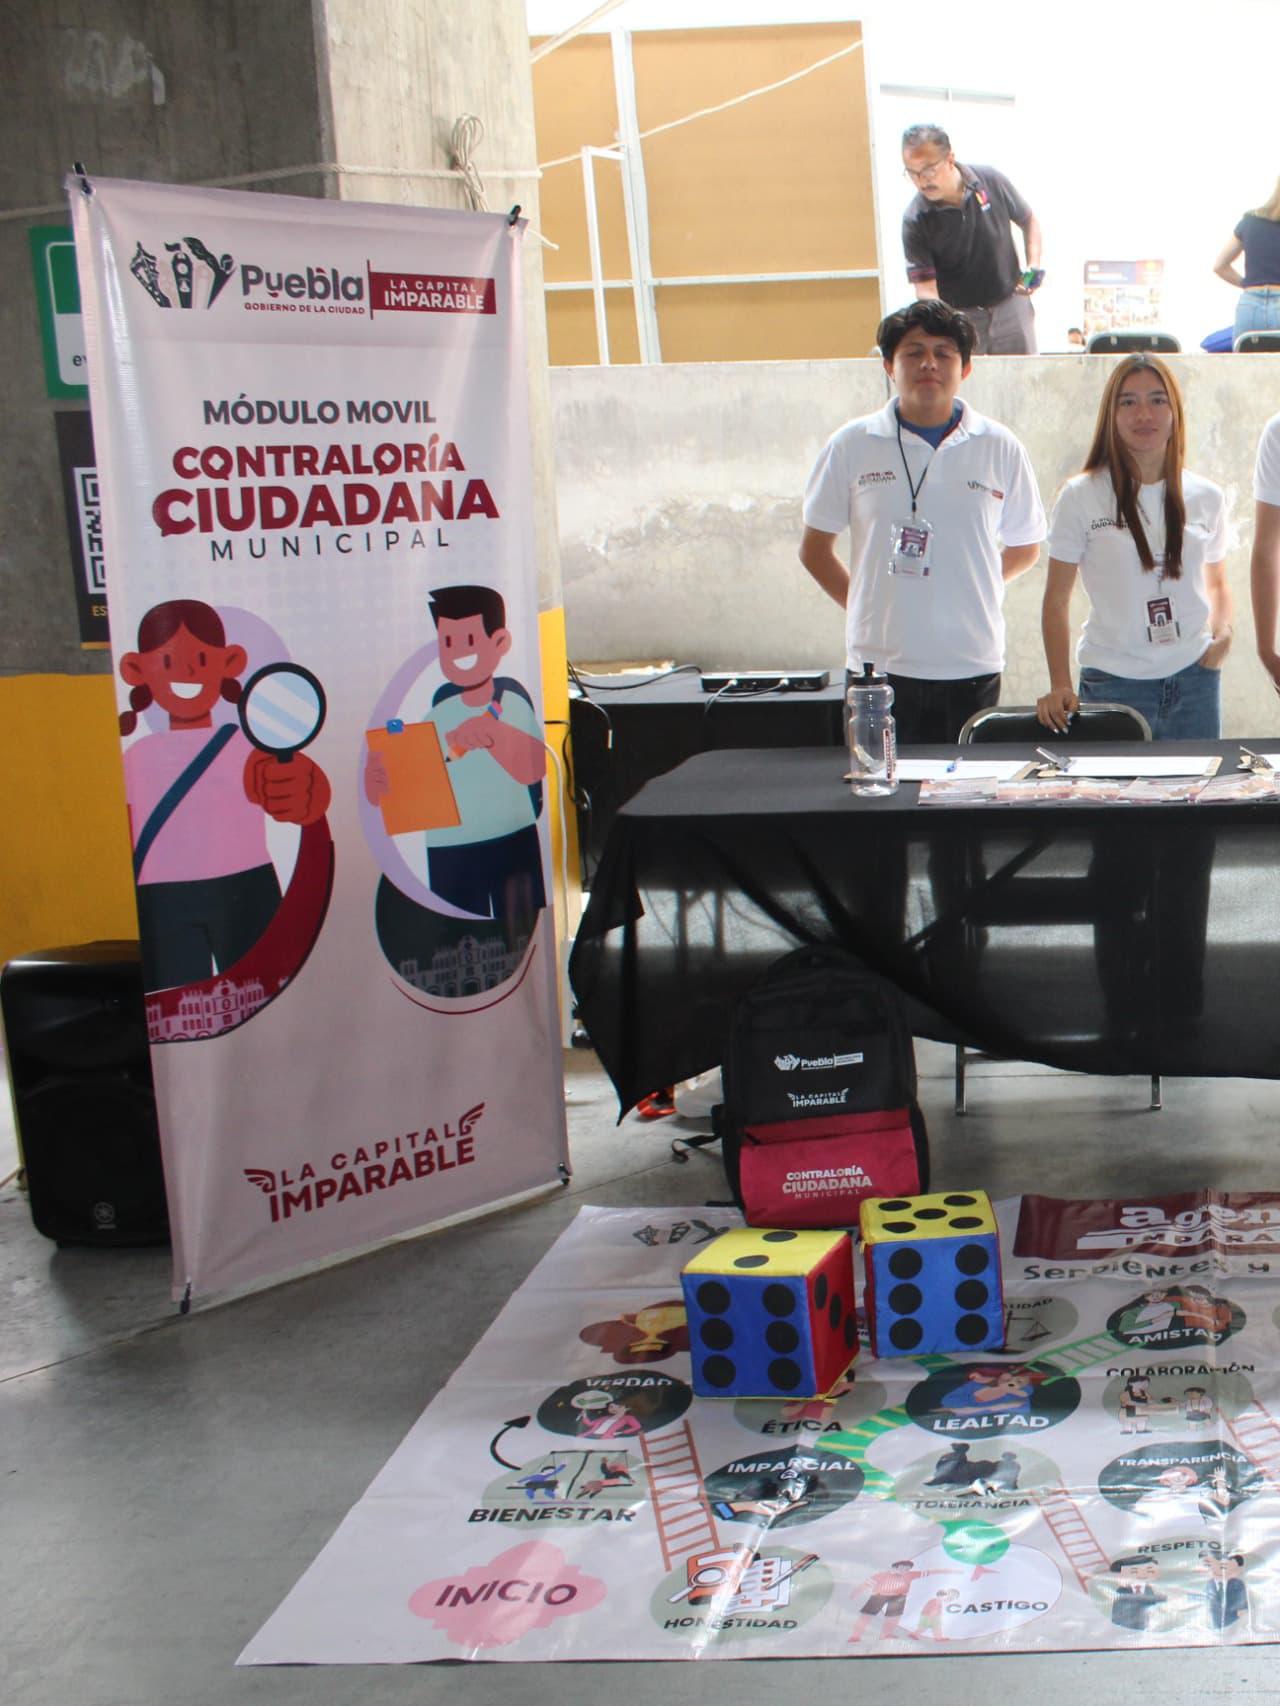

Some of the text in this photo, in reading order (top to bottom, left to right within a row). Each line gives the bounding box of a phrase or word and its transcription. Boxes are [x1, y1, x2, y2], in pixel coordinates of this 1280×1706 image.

[241, 264, 364, 300] Puebla
[389, 280, 477, 293] LA CAPITAL
[244, 302, 365, 315] GOBIERNO DE LA CIUDAD
[384, 290, 485, 311] IMPARABLE
[203, 393, 437, 425] MÓDULO MOVIL
[172, 432, 466, 481] CONTRALORÍA
[152, 478, 500, 537] CIUDADANA
[211, 528, 449, 562] MUNICIPAL
[793, 1095, 846, 1107] IMPARABLE
[281, 1123, 457, 1186] LA CAPITAL
[269, 1136, 476, 1223] IMPARABLE
[786, 1164, 864, 1180] CONTRALORÍA
[782, 1175, 873, 1194] CIUDADANA
[1128, 1327, 1223, 1344] AMISTAD
[586, 1377, 672, 1387] VERDAD
[761, 1419, 843, 1434] ÉTICA
[933, 1413, 1049, 1431] LEALTAD
[727, 1457, 856, 1473] IMPARCIAL
[1118, 1452, 1248, 1467] TRANSPARENCIA
[468, 1507, 637, 1523] BIENESTAR
[1137, 1540, 1222, 1553] RESPETO
[435, 1580, 578, 1607] INICIO
[946, 1600, 1049, 1614] CASTIGO
